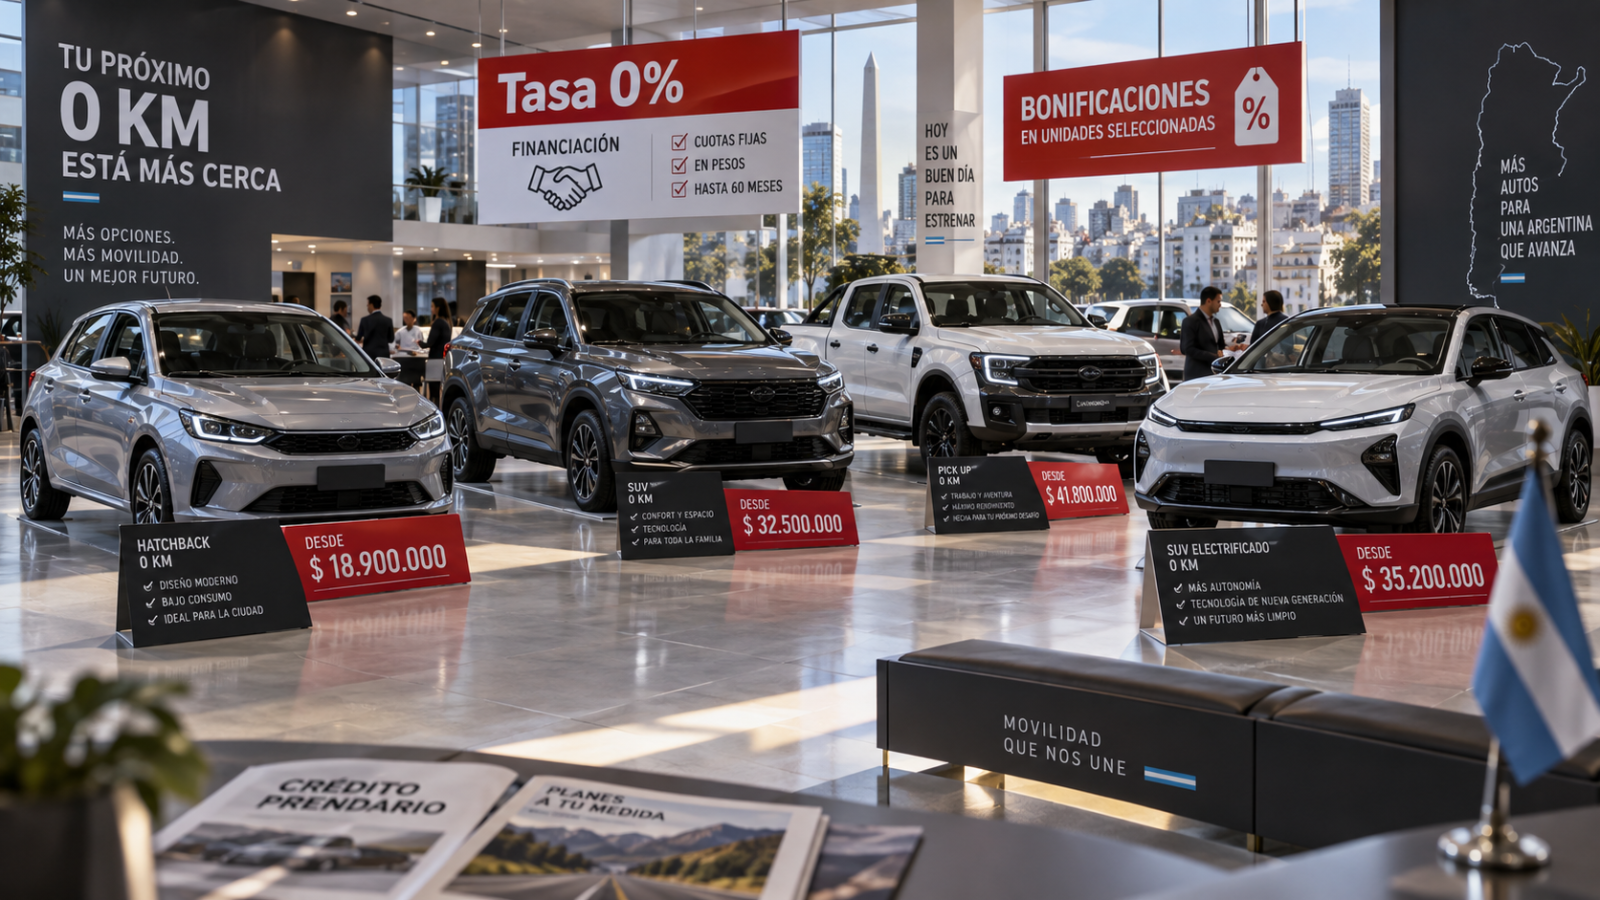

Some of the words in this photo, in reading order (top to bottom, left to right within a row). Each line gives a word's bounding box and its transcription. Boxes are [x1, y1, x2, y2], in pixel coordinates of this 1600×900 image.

[58, 43, 92, 72] TU
[101, 50, 210, 90] PRÓXIMO
[498, 72, 596, 114] Tasa
[610, 59, 684, 107] 0%
[1021, 79, 1210, 121] BONIFICACIONES
[60, 81, 100, 142] 0
[118, 88, 209, 153] KM
[925, 123, 949, 138] HOY
[1021, 130, 1037, 145] EN
[1041, 124, 1103, 144] UNIDADES
[1108, 115, 1215, 139] SELECCIONADAS
[513, 134, 619, 157] FINANCIACIÓN
[695, 134, 735, 148] CUOTAS
[738, 132, 767, 146] FIJAS
[925, 146, 940, 161] ES
[943, 145, 957, 160] UN
[62, 151, 131, 181] ESTÁ
[139, 155, 194, 186] MÁS
[202, 162, 281, 192] CERCA
[695, 159, 708, 171] EN
[712, 158, 745, 171] PESOS
[1500, 154, 1525, 174] MÁS
[925, 168, 954, 183] BUEN
[958, 164, 974, 182] DÍA
[695, 182, 728, 195] HASTA
[731, 181, 744, 194] 60
[748, 180, 783, 193] MESES
[1501, 177, 1538, 195] AUTOS
[925, 191, 954, 206] PARA
[1501, 199, 1530, 215] PARA
[925, 213, 975, 228] ESTRENAR
[1501, 220, 1524, 236] UNA
[1527, 215, 1593, 234] ARGENTINA
[64, 223, 95, 241] MÁS
[100, 227, 175, 244] OPCIONES.
[64, 245, 95, 262] MÁS
[101, 248, 183, 264] MOVILIDAD.
[1501, 243, 1524, 259] QUE
[1528, 240, 1575, 257] AVANZA
[64, 269, 85, 282] UN
[90, 270, 137, 285] MEJOR
[142, 271, 199, 285] FUTURO.
[938, 466, 958, 474] PICK
[960, 466, 971, 474] UP
[1042, 471, 1065, 481] DESDE
[628, 482, 648, 492] SUV
[939, 477, 945, 485] 0
[947, 477, 960, 485] KM
[629, 495, 635, 504] 0
[638, 494, 653, 504] KM
[1046, 486, 1054, 505] $
[1057, 485, 1117, 505] 41.800.000
[740, 499, 770, 510] DESDE
[642, 511, 675, 520] CONFORT
[677, 511, 682, 519] Y
[684, 510, 714, 519] ESPACIO
[643, 523, 687, 533] TECNOLOGÍA
[743, 516, 752, 536] $
[758, 514, 842, 535] 32.500.000
[138, 536, 210, 552] HATCHBACK
[305, 534, 344, 550] DESDE
[644, 537, 662, 545] PARA
[664, 537, 682, 545] TODA
[685, 536, 693, 544] LA
[696, 535, 722, 544] FAMILIA
[1167, 543, 1189, 556] SUV
[1192, 541, 1269, 556] ELECTRIFICADO
[1357, 546, 1392, 560] DESDE
[140, 556, 148, 569] 0
[152, 554, 172, 568] KM
[310, 555, 323, 582] $
[329, 544, 447, 579] 18.900.000
[1169, 559, 1177, 572] 0
[1181, 559, 1198, 571] KM
[160, 577, 192, 590] DISEÑO
[195, 575, 238, 588] MODERNO
[1188, 581, 1207, 592] MÁS
[1210, 579, 1261, 592] AUTONOMÍA
[1362, 566, 1375, 593] $
[1382, 563, 1484, 592] 35.200.000
[162, 595, 185, 607] BAJO
[188, 592, 232, 605] CONSUMO
[1191, 597, 1245, 609] TECNOLOGÍA
[1248, 596, 1258, 607] DE
[1261, 595, 1289, 606] NUEVA
[1291, 591, 1344, 605] GENERACIÓN
[164, 612, 188, 624] IDEAL
[190, 610, 215, 622] PARA
[218, 609, 229, 619] LA
[232, 605, 263, 618] CIUDAD
[1193, 615, 1206, 625] UN
[1209, 613, 1243, 625] FUTURO
[1246, 611, 1265, 622] MÁS
[1268, 611, 1296, 622] LIMPIO
[1004, 715, 1101, 747] MOVILIDAD
[1004, 737, 1037, 757] QUE
[1046, 745, 1081, 766] NOS
[1090, 755, 1126, 776] UNE
[279, 777, 420, 796] CRÉDITO
[547, 786, 625, 804] PLANES
[257, 795, 447, 815] PRENDARIO
[535, 798, 550, 806] A
[559, 799, 584, 810] TU
[589, 804, 665, 821] MEDIDA
